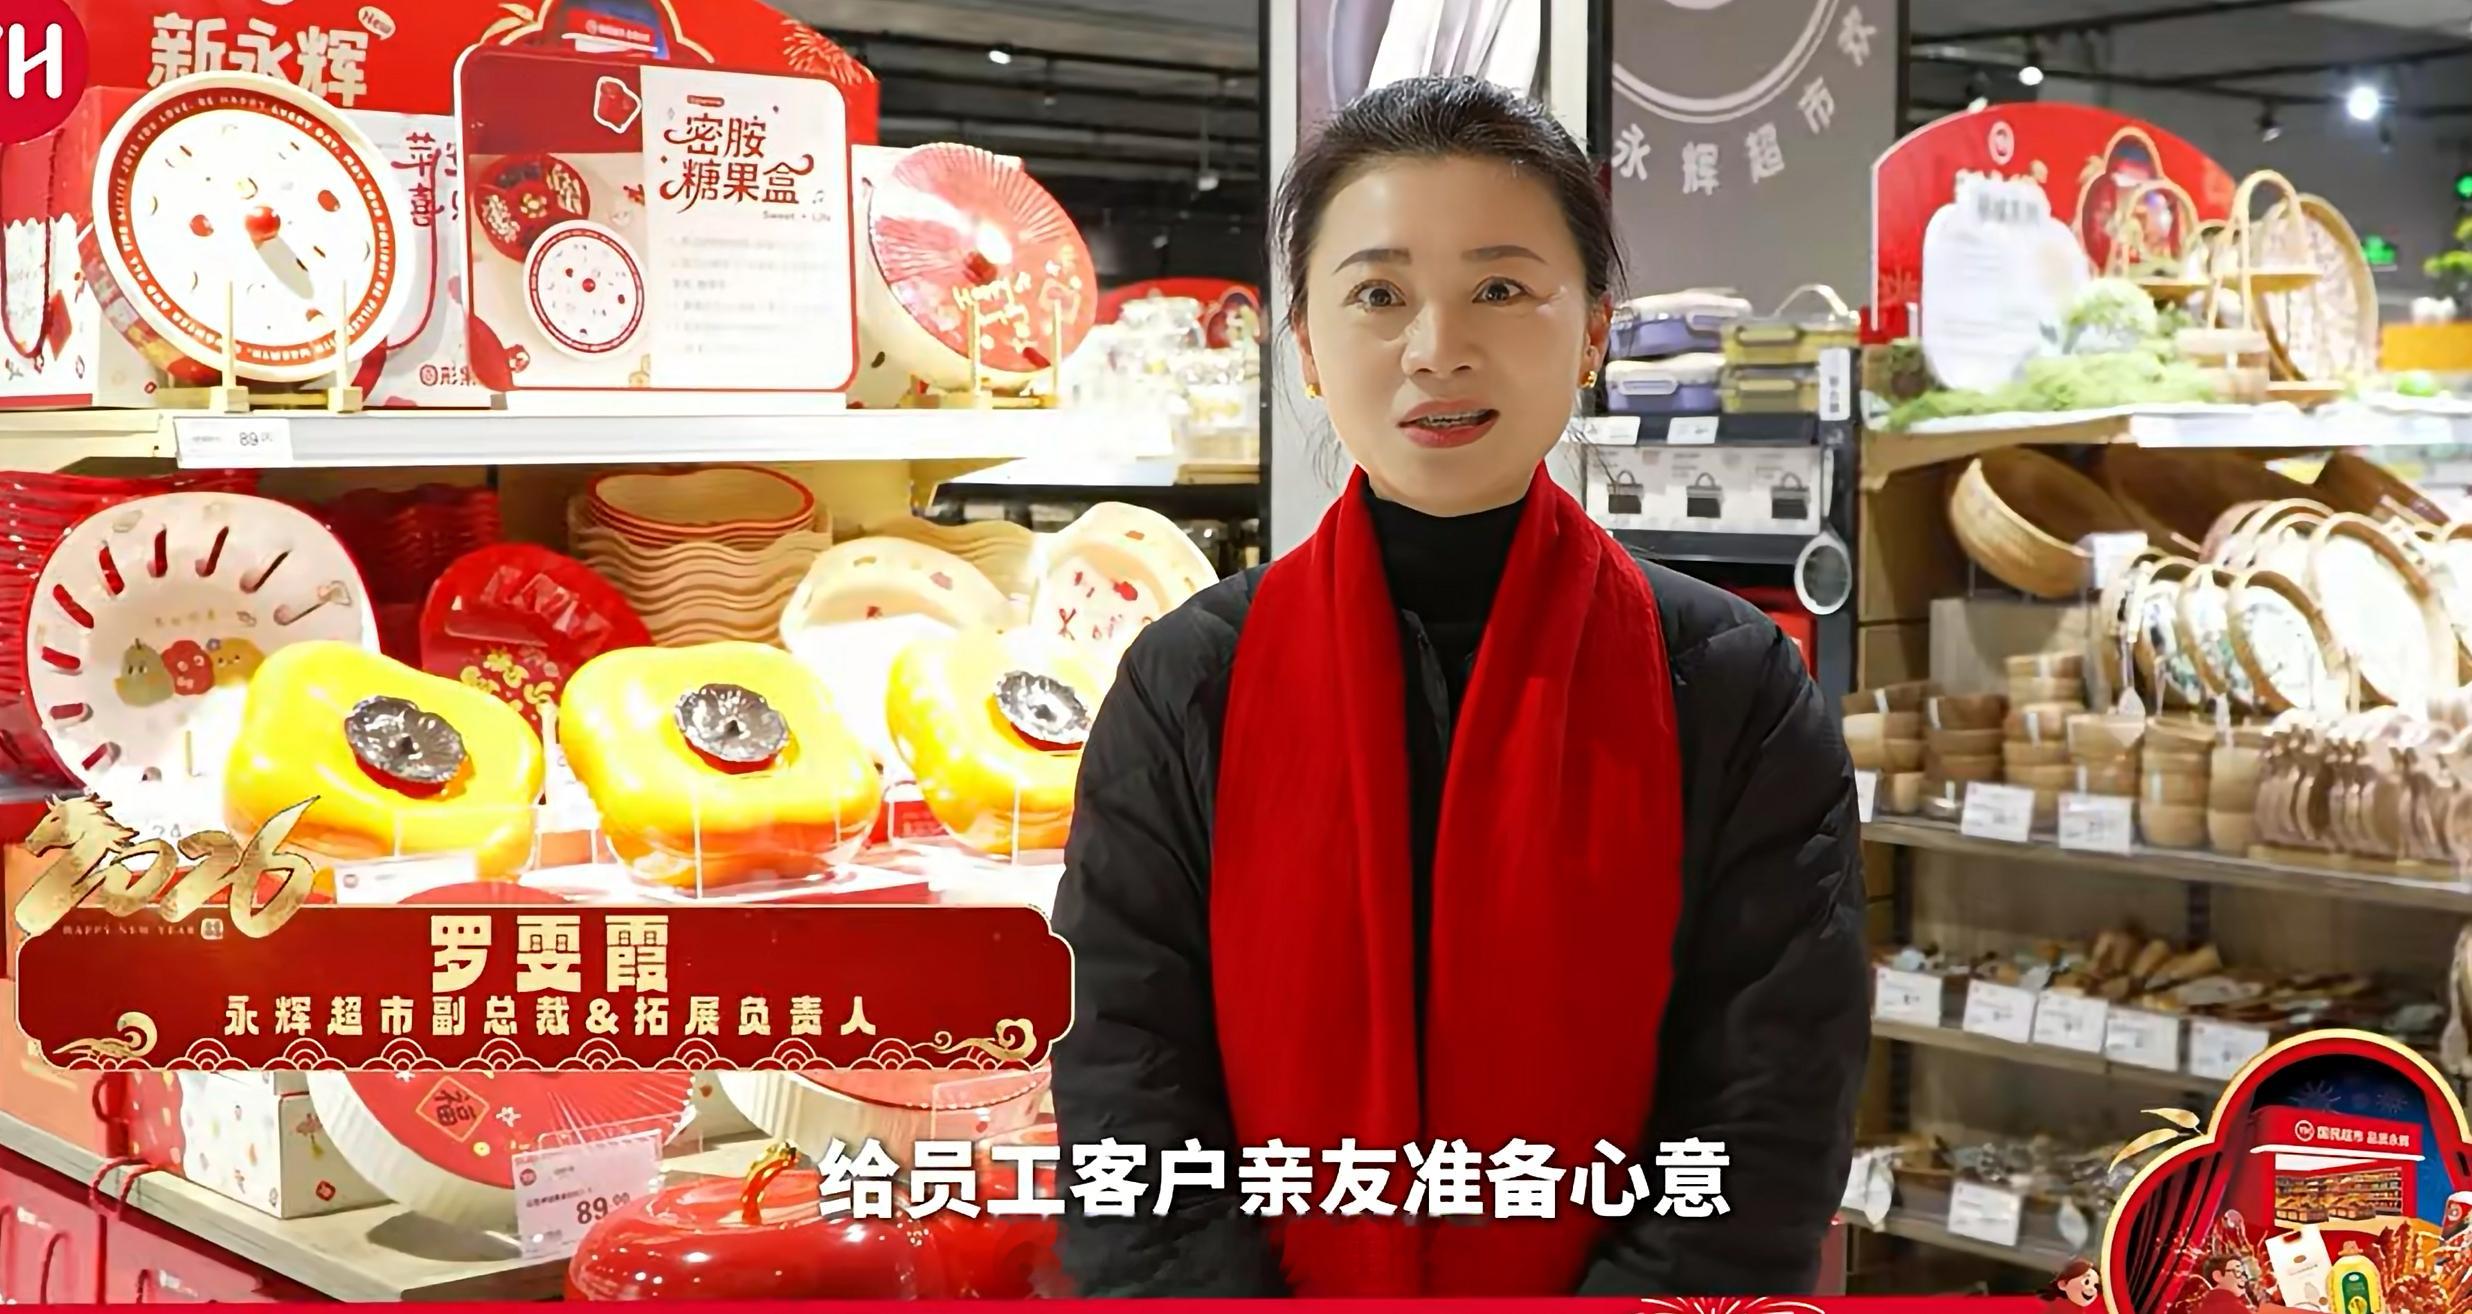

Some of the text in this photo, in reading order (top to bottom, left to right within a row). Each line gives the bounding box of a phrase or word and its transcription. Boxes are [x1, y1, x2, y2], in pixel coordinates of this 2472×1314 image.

[147, 12, 368, 107] 新永辉
[663, 112, 767, 158] 密胺
[659, 153, 814, 214] 糖果盒
[433, 1089, 477, 1127] 福
